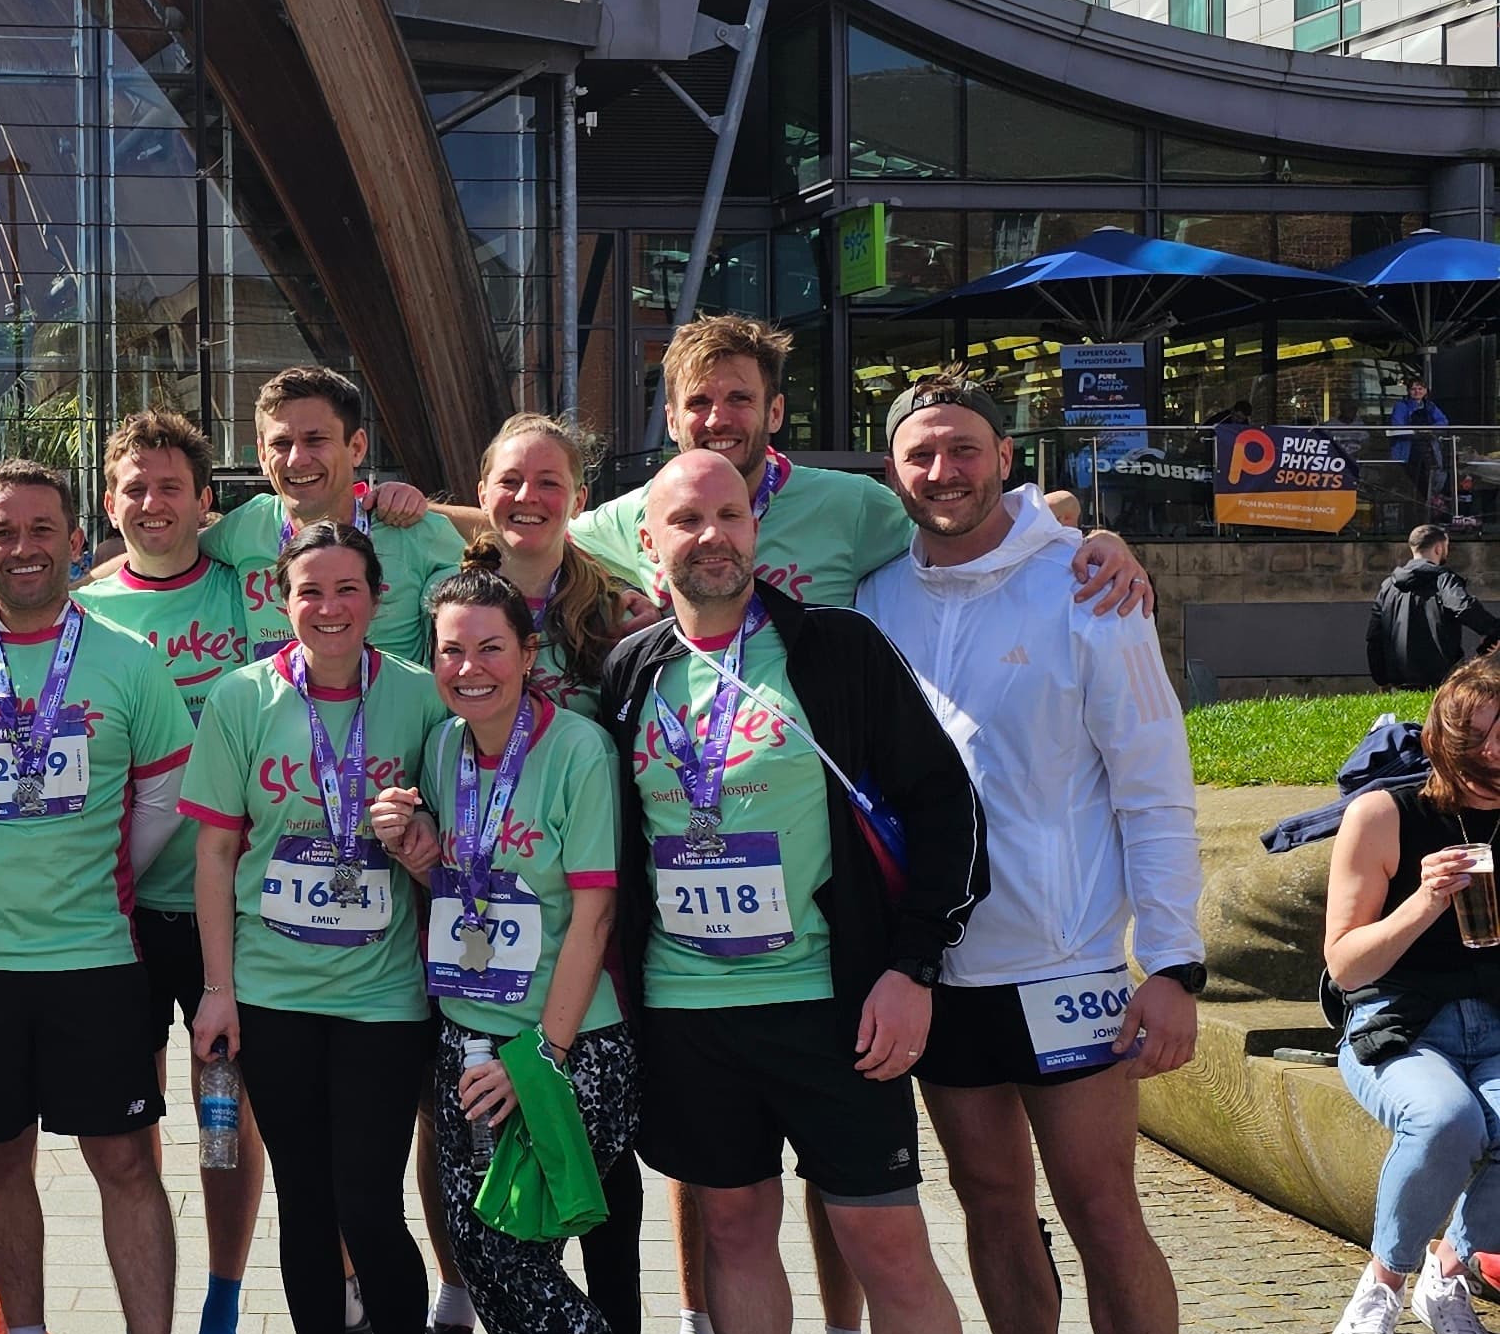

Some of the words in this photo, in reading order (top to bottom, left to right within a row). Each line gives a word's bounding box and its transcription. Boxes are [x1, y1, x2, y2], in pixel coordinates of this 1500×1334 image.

[1074, 357, 1131, 365] PHYSIOTHERAPY
[1282, 436, 1331, 455] PURE
[1280, 453, 1346, 473] PHYSIO
[1275, 470, 1344, 489] SPORTS
[1257, 501, 1275, 509] PAIN
[704, 856, 747, 865] MARATHON
[675, 884, 760, 914] 2118
[311, 915, 341, 925] EMILY
[451, 915, 520, 946] 679
[706, 924, 731, 933] ALEX
[505, 991, 525, 1001] 6279
[1047, 1057, 1061, 1066] RUN
[1062, 1055, 1074, 1063] FOR
